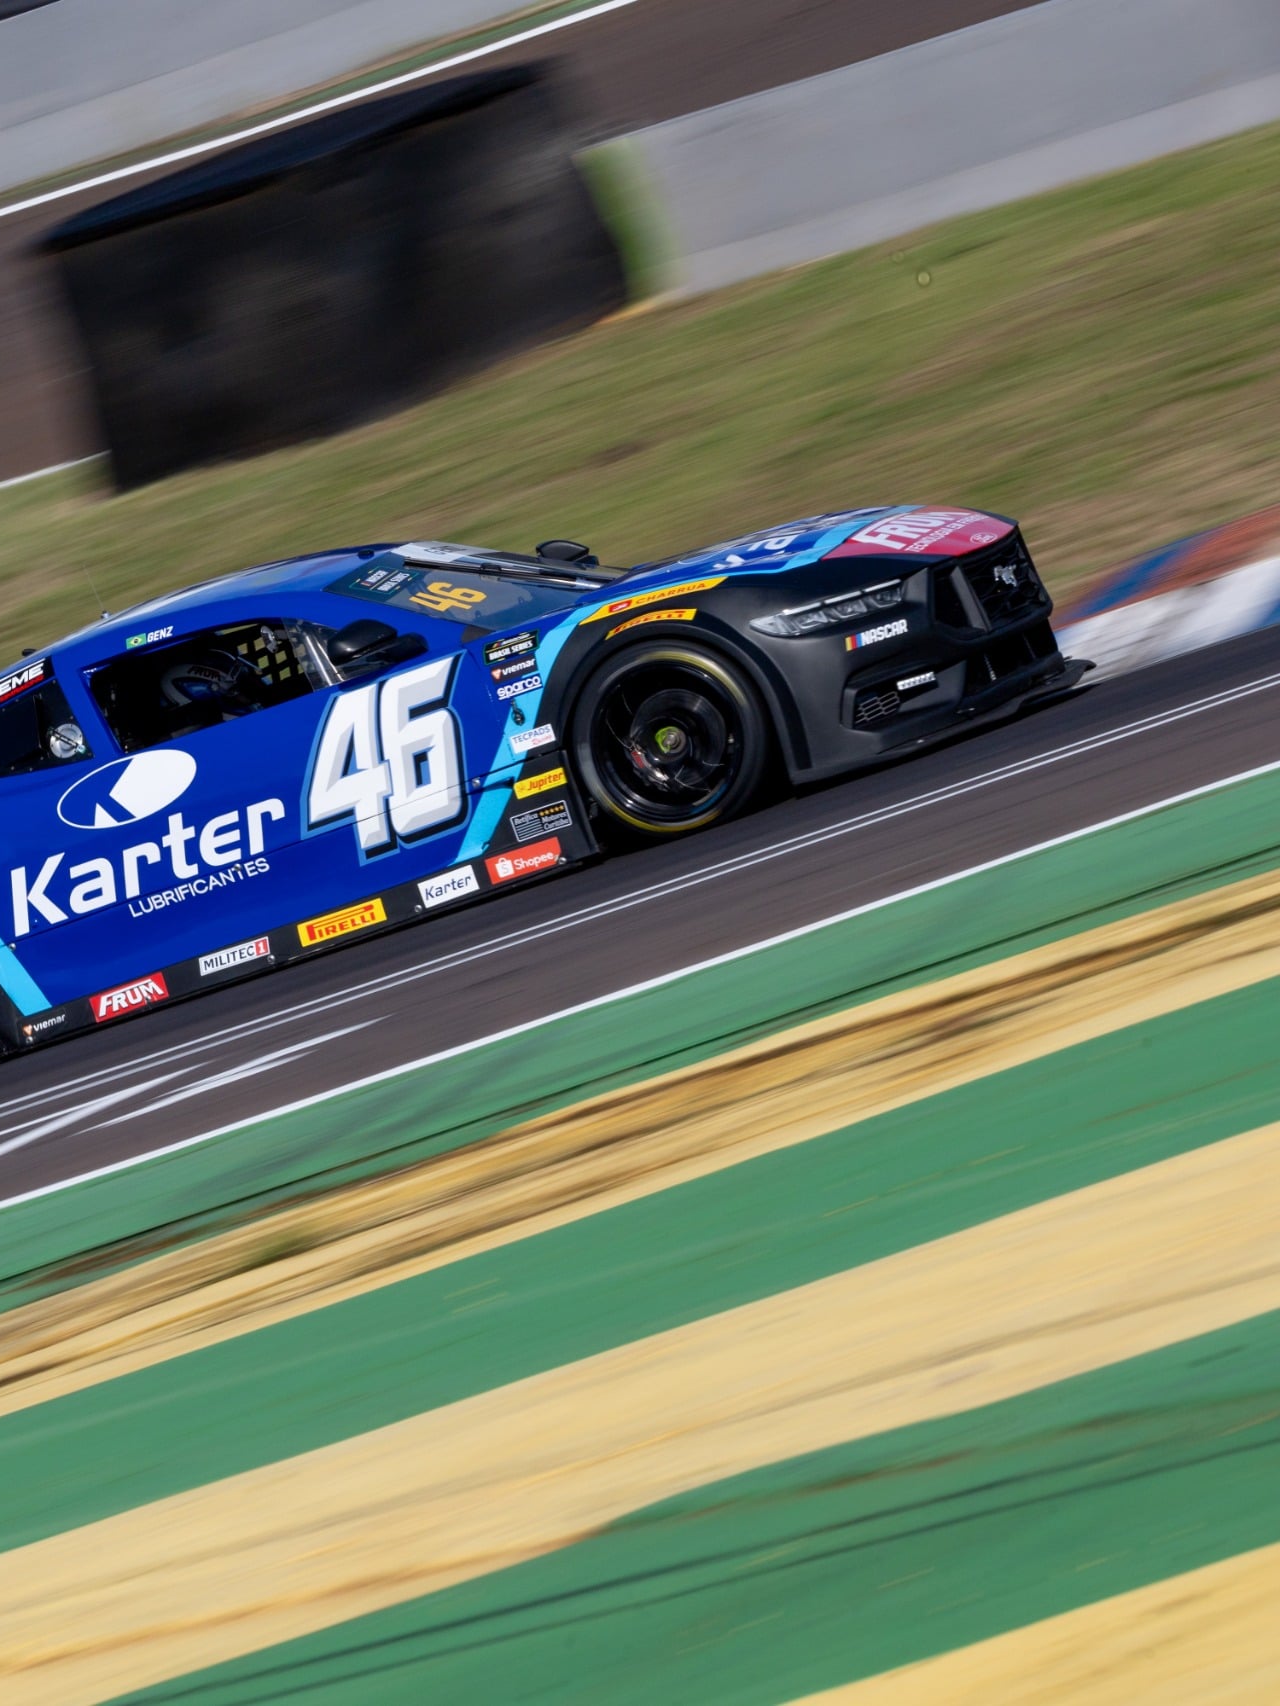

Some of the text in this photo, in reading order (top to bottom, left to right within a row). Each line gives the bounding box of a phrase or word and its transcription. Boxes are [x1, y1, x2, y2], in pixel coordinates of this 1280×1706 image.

[851, 511, 971, 550] FRUM
[409, 582, 487, 612] 46
[636, 583, 706, 604] CHARRUA
[147, 626, 174, 643] GENZ
[861, 619, 908, 646] NASCAR
[497, 676, 541, 699] sparco
[512, 726, 551, 744] TECPADS
[304, 653, 468, 860] 46
[528, 773, 564, 791] Jupiter
[10, 798, 285, 937] Karter
[513, 852, 554, 870] Shopee
[128, 859, 271, 918] LUBRIFICANTES
[425, 876, 472, 902] Karter
[306, 904, 376, 942] PIRELLI
[98, 979, 164, 1017] FRUM
